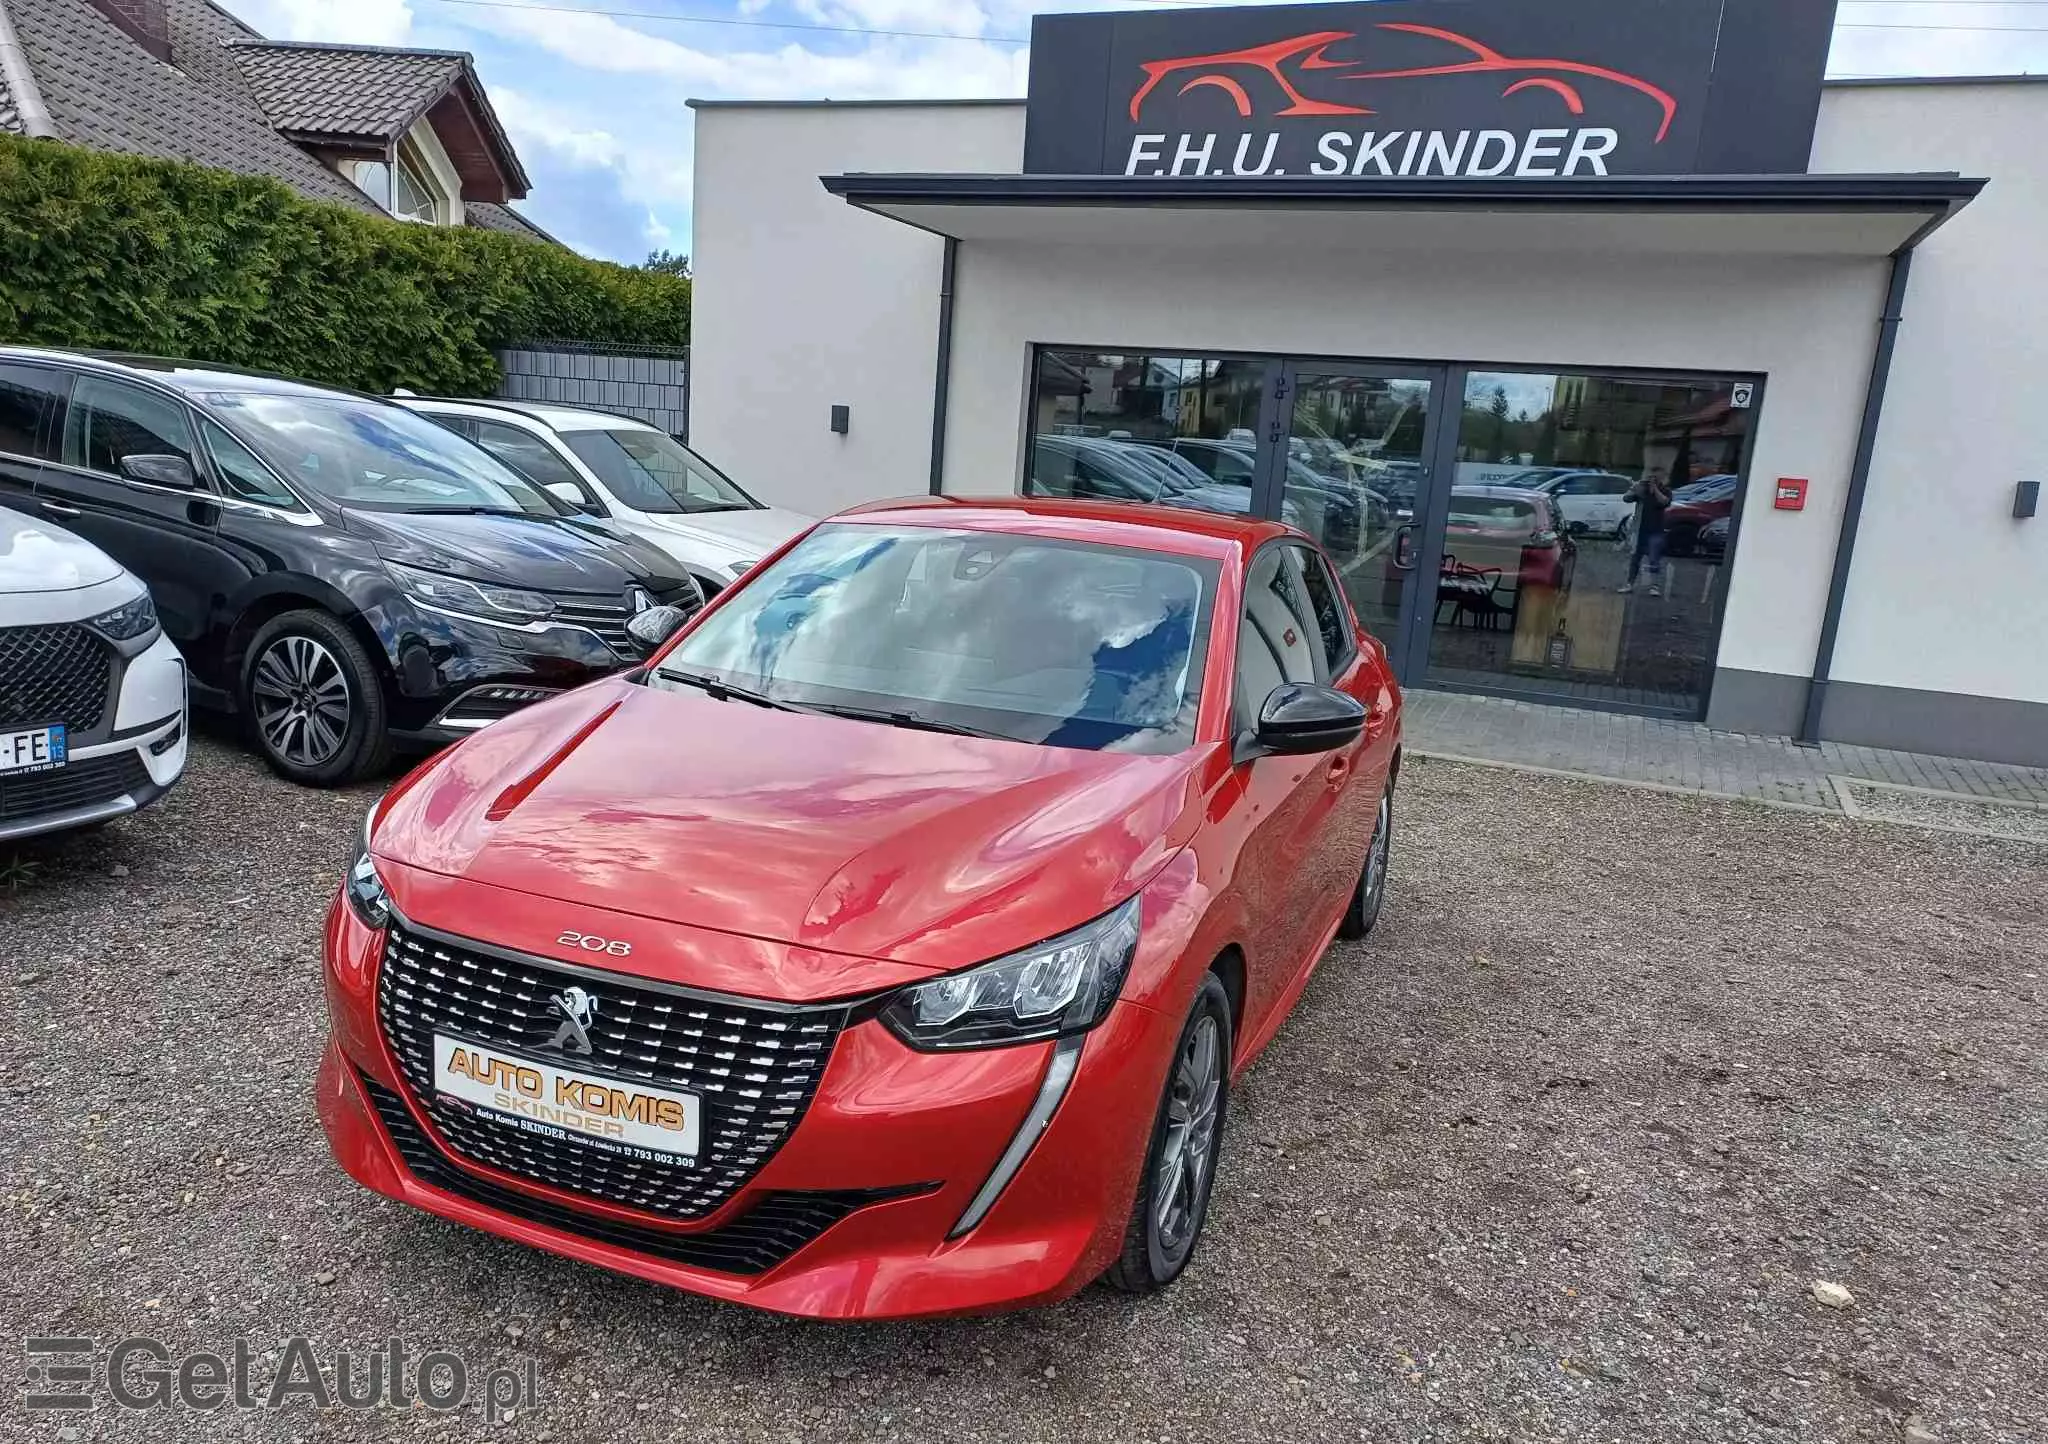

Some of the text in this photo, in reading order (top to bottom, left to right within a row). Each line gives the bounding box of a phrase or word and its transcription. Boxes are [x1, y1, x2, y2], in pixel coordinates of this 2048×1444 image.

[1124, 127, 1619, 176] F.H.U. SKINDER
[51, 745, 65, 759] 13
[556, 930, 632, 957] 208
[447, 1047, 685, 1132] AUTO KOMIS
[475, 1107, 695, 1168] Auto Komis SKINDER 793 002 309
[493, 1092, 625, 1138] SKINDER
